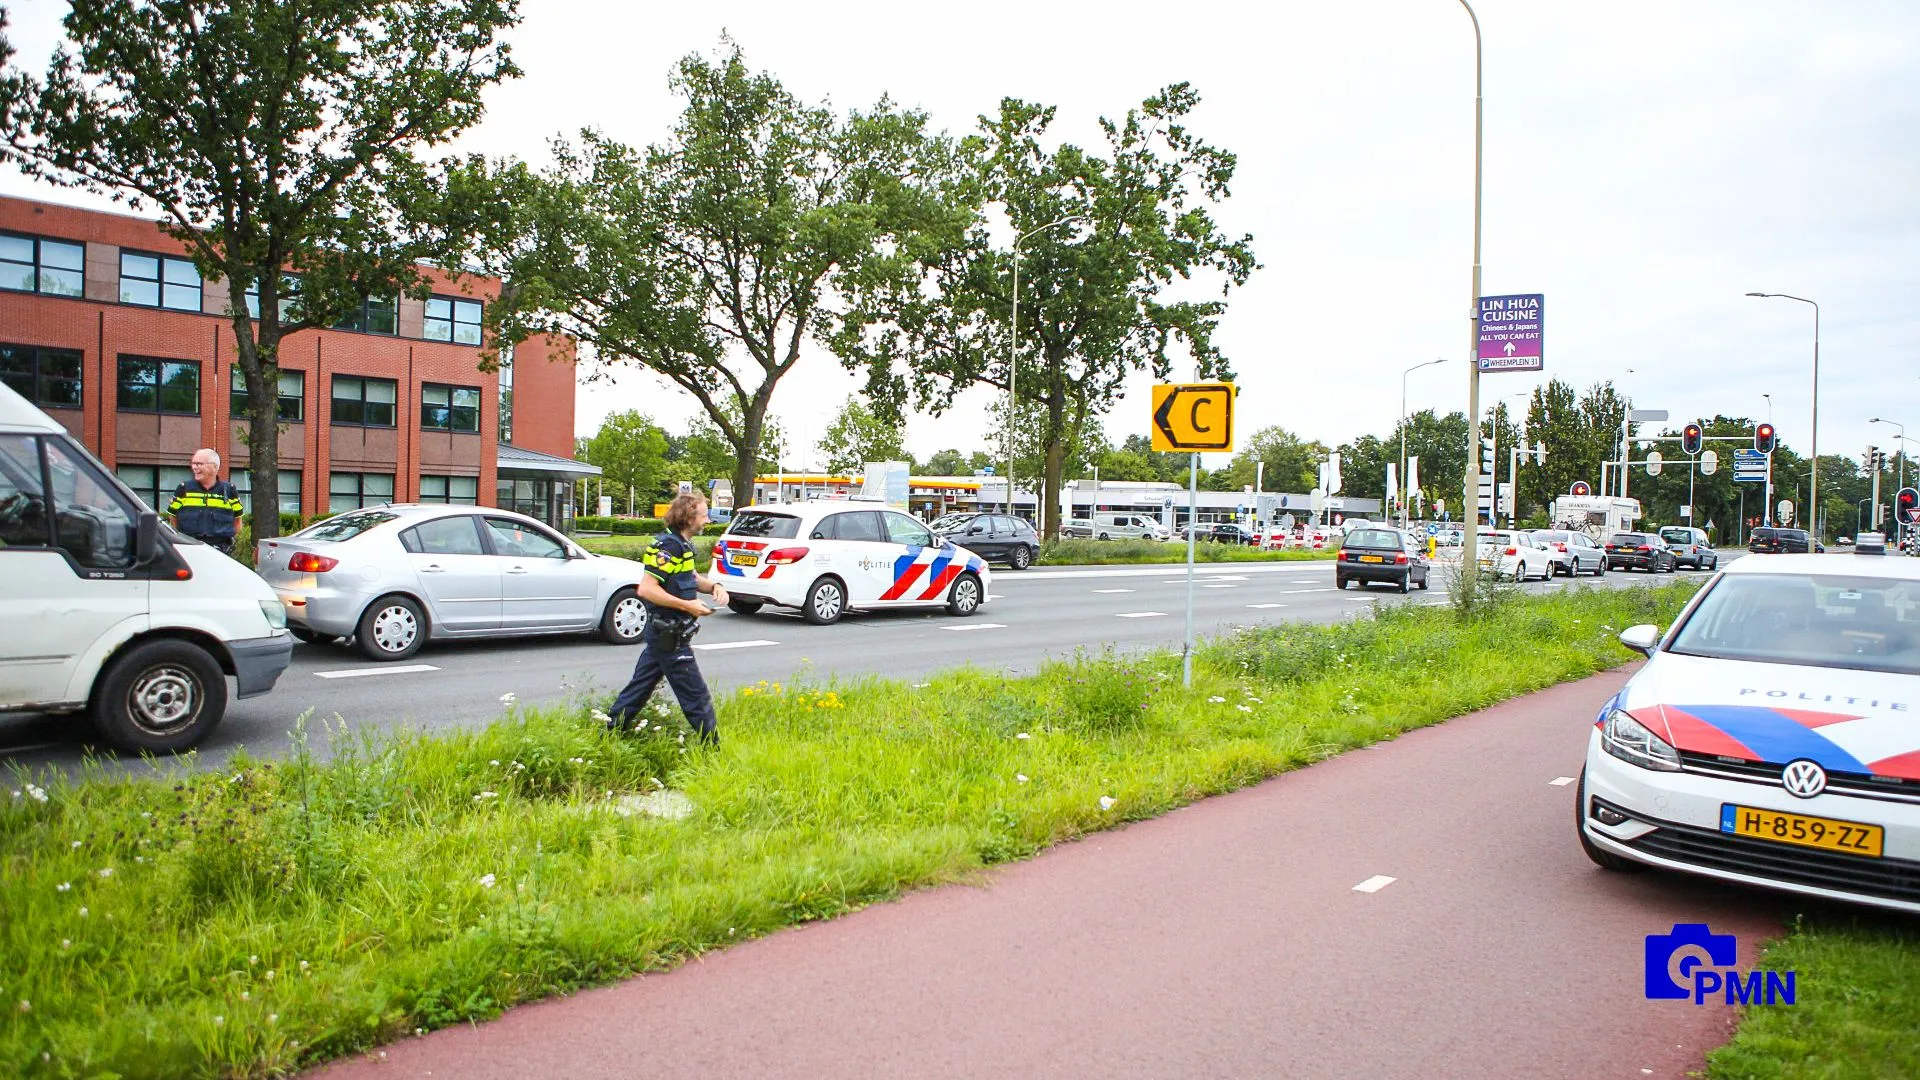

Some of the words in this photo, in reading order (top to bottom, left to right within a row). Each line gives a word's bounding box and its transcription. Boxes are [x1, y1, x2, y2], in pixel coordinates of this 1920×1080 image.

[1482, 300, 1503, 311] LIN
[1508, 298, 1539, 309] HUA
[1483, 310, 1537, 322] CUISINE
[1515, 323, 1538, 332] Japans
[1494, 333, 1508, 341] YOU
[1490, 358, 1529, 367] WHEEMPLEIN
[1530, 358, 1538, 366] 31
[1191, 398, 1211, 433] C
[1739, 688, 1910, 712] POLITIE
[1744, 811, 1871, 850] H-859-ZZ
